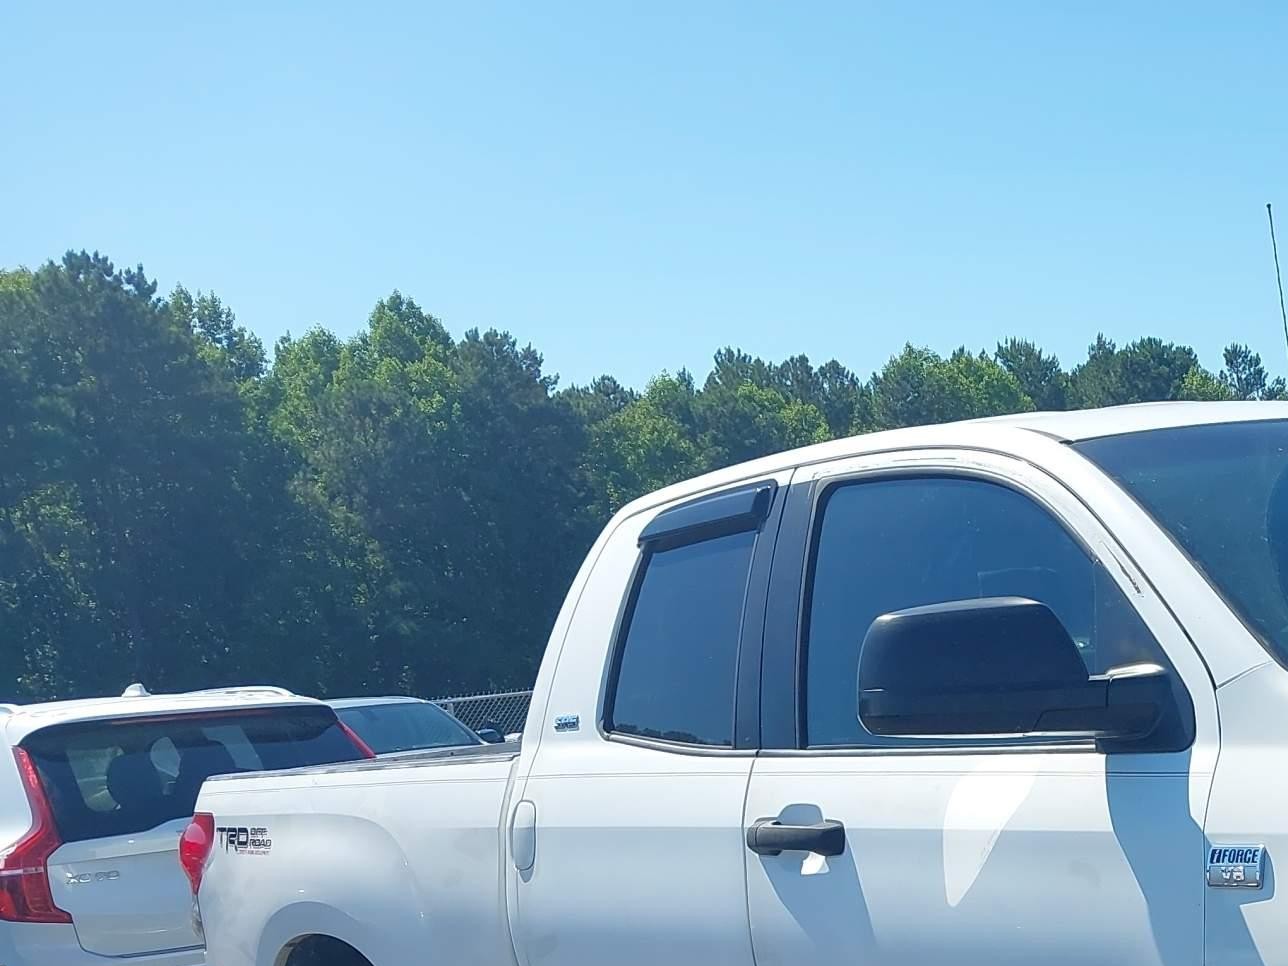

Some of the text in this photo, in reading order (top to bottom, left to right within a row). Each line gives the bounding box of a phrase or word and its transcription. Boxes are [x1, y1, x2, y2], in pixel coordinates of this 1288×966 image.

[250, 827, 268, 837] OFF
[216, 826, 249, 853] TRD
[249, 838, 272, 849] ROAD
[1220, 866, 1245, 881] V8
